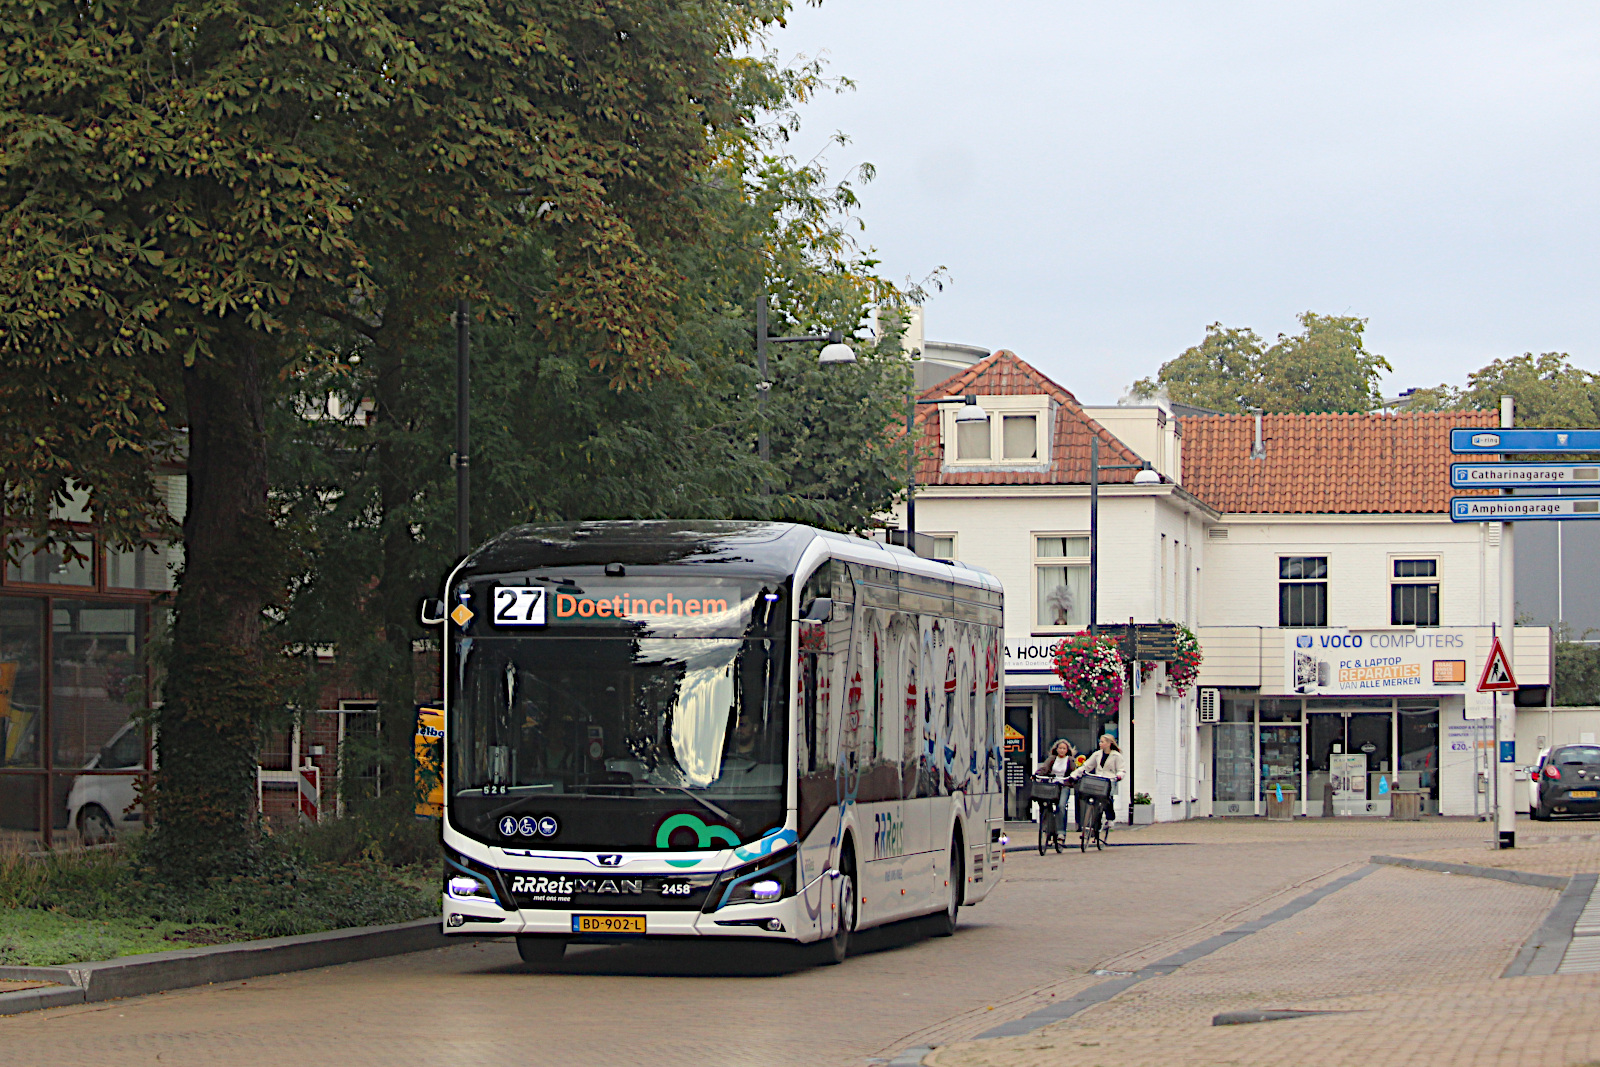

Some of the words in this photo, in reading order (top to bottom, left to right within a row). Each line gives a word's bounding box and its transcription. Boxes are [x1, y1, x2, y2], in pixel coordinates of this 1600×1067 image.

[1471, 469, 1565, 481] Catharinagarage
[1471, 503, 1561, 515] Amphiongarage
[496, 589, 542, 621] 27
[556, 592, 728, 618] Doetinchem
[1320, 635, 1363, 648] VOCO
[1370, 634, 1464, 648] COMPUTERS
[1018, 644, 1057, 659] HOUS
[1340, 660, 1352, 669] PC
[1354, 659, 1362, 668] &
[1364, 657, 1402, 668] LAPTOP
[1340, 665, 1420, 682] REPARATIES
[1340, 682, 1358, 690] VAN
[1360, 680, 1380, 688] ALLE
[1382, 677, 1421, 687] MERKEN
[1451, 743, 1472, 751] €20,-
[874, 806, 904, 859] RRReis
[511, 876, 574, 894] RRReis
[574, 879, 643, 894] MAN
[661, 884, 691, 895] 2458
[583, 919, 642, 930] BD-902-L
